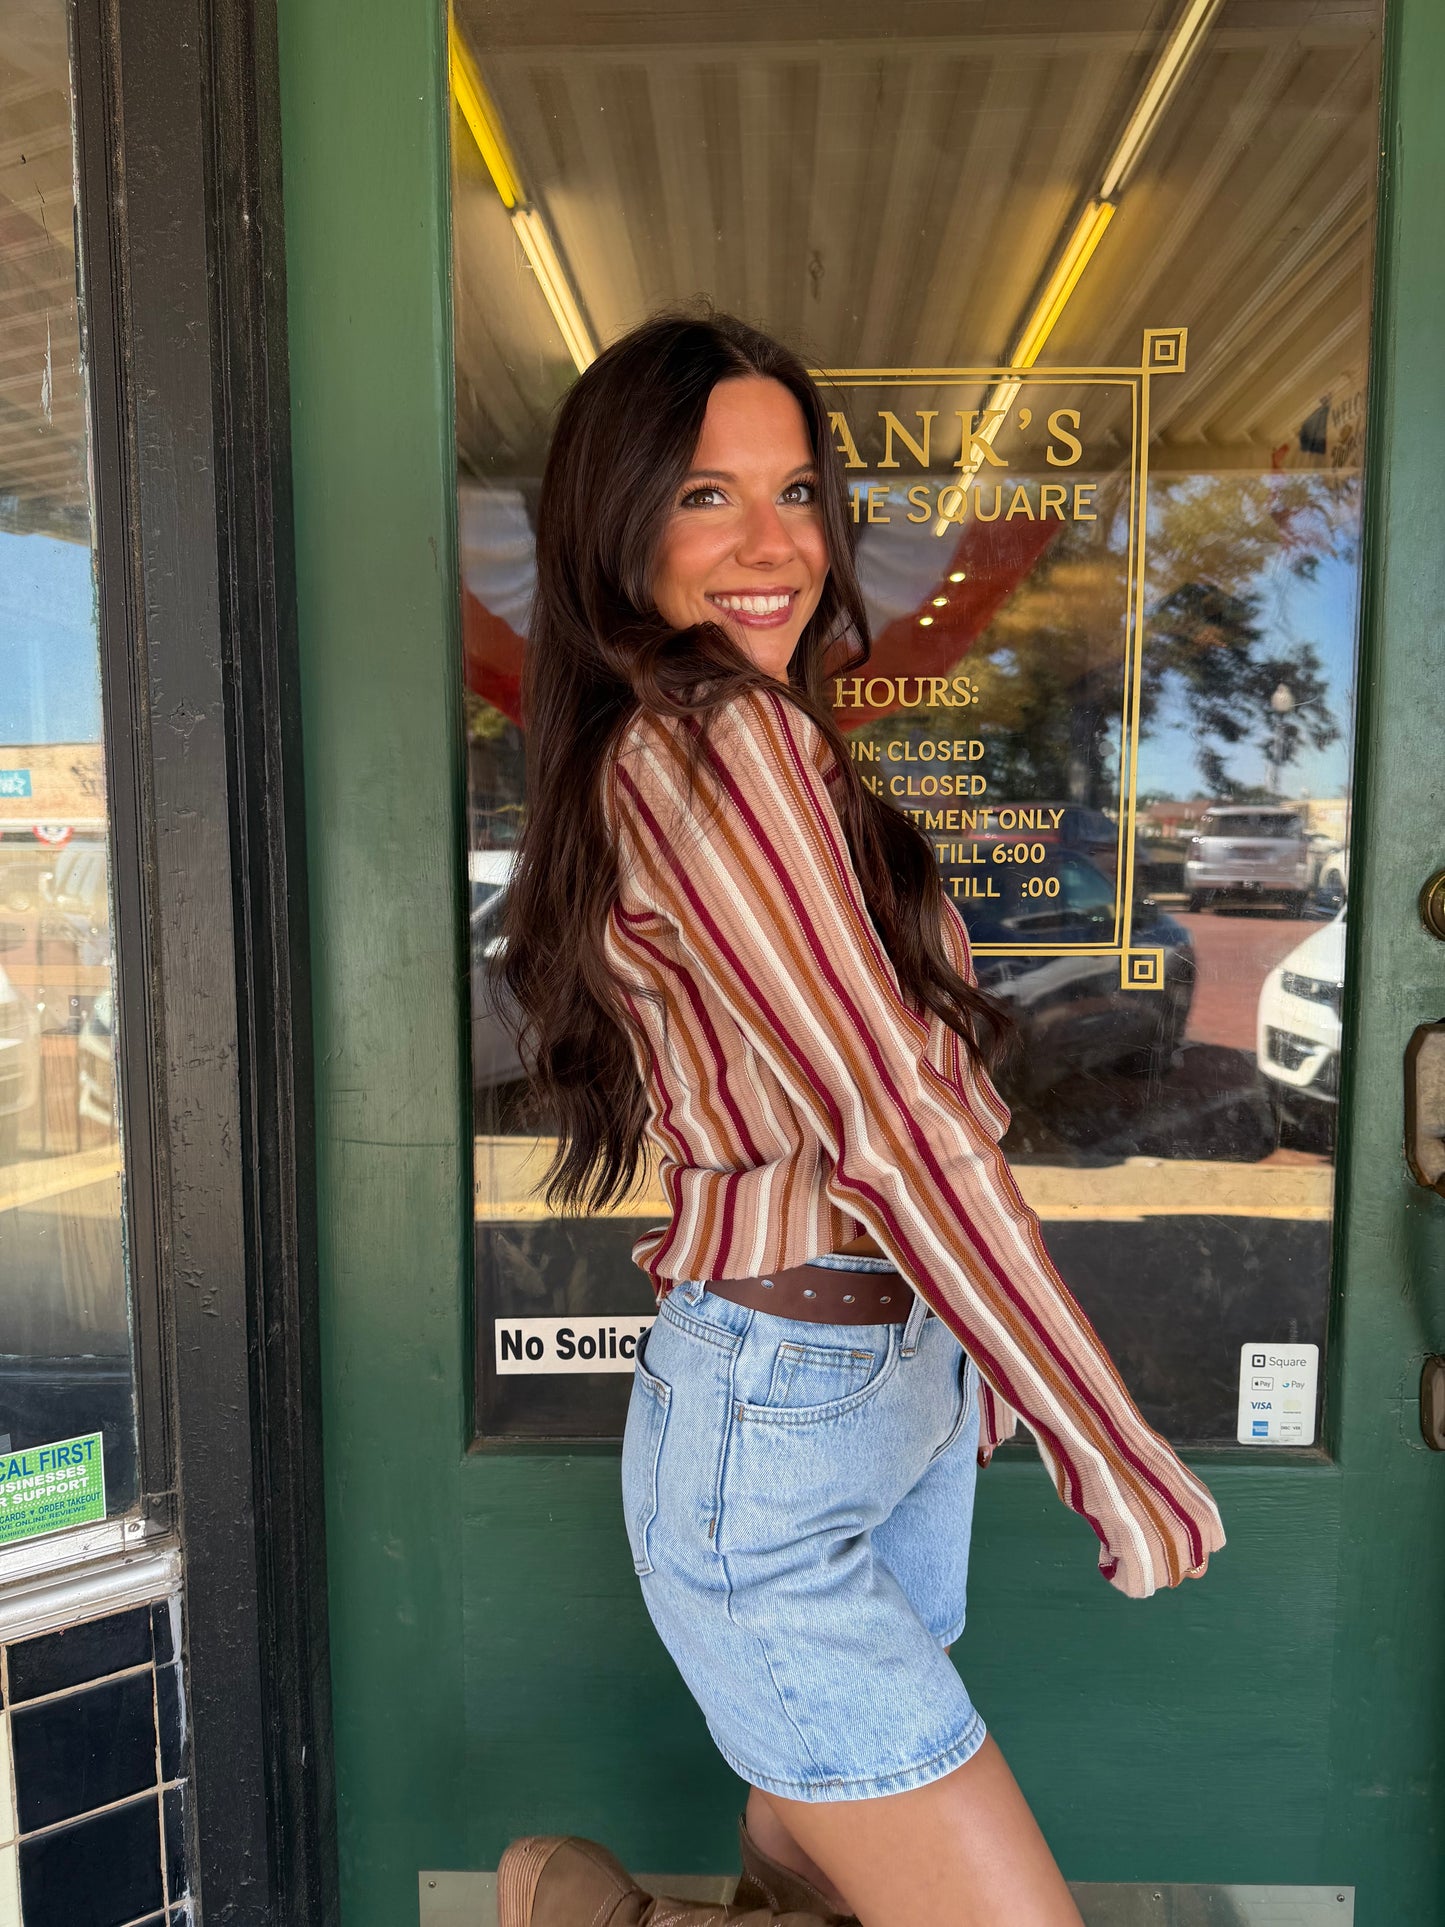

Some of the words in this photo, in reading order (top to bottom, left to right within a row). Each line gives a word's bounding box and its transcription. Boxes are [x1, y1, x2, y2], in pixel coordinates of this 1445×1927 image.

[906, 483, 1097, 525] SQUARE
[832, 676, 980, 708] HOURS:
[887, 740, 985, 762] CLOSED
[889, 775, 987, 796] CLOSED
[903, 809, 994, 830] TMENT
[998, 809, 1065, 830] ONLY
[935, 843, 986, 864] TILL
[991, 842, 1046, 864] 6:00
[949, 877, 1001, 898] TILL
[1021, 876, 1061, 898] :00
[501, 1329, 544, 1361] No
[556, 1326, 647, 1361] Solic
[1269, 1357, 1307, 1368] Square
[1291, 1380, 1305, 1390] Pay
[1251, 1402, 1272, 1410] VISA
[39, 1440, 95, 1472] FIRST
[12, 1477, 90, 1505] SUPPORT
[38, 1501, 65, 1515] ORDER
[67, 1491, 101, 1506] TAKEOUT
